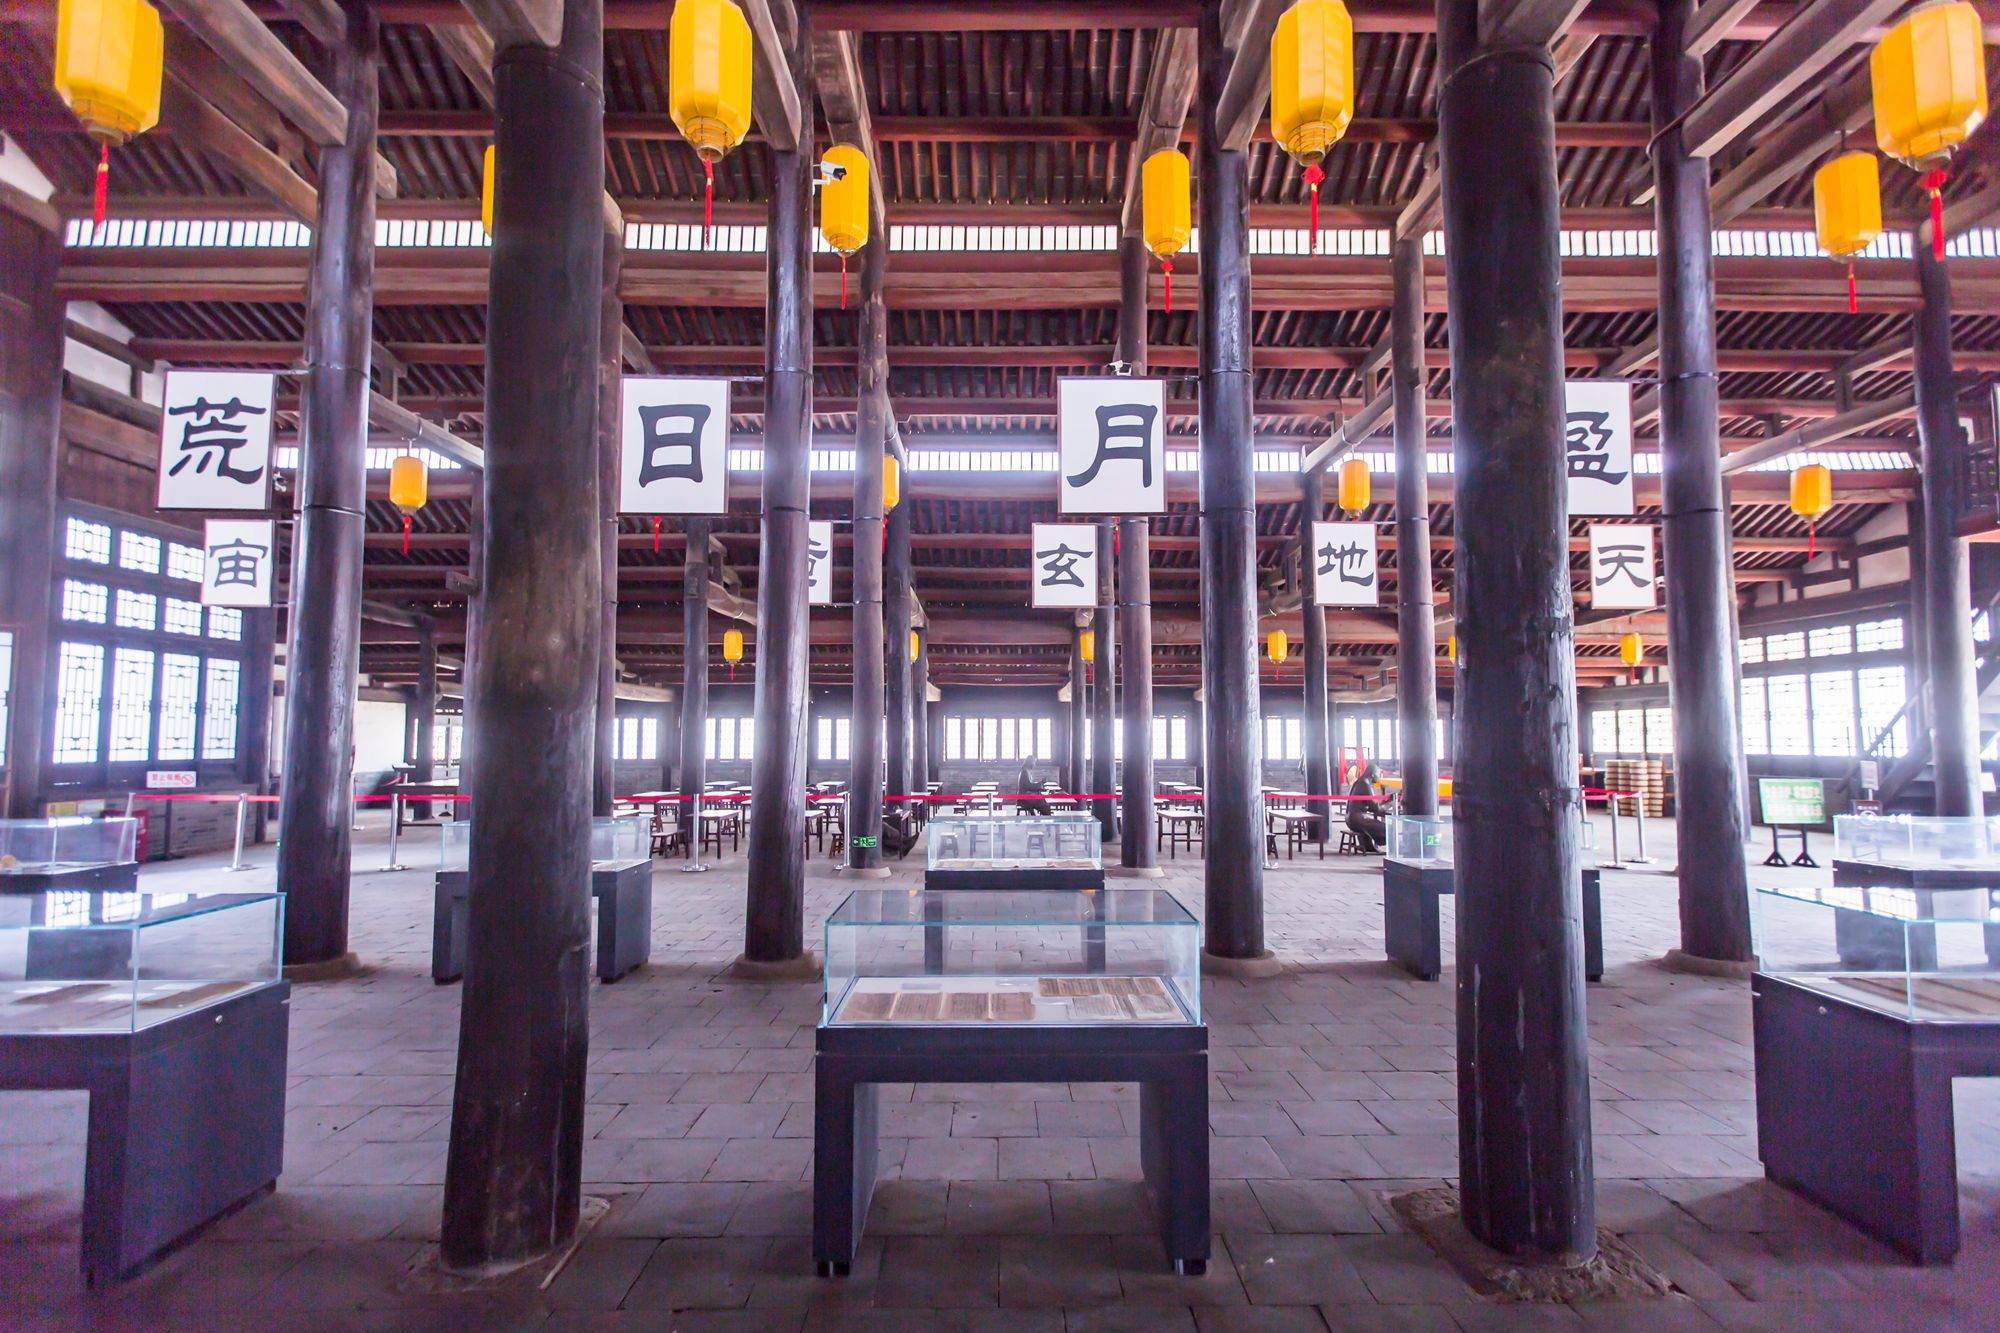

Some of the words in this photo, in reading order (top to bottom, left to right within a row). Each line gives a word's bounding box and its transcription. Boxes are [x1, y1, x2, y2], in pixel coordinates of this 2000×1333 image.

[168, 396, 267, 485] 荒
[637, 403, 712, 489] 日
[1066, 403, 1158, 489] 月
[209, 537, 269, 588] 宙
[1035, 542, 1094, 588] 玄
[1317, 540, 1373, 587] 地
[1595, 544, 1651, 588] 天
